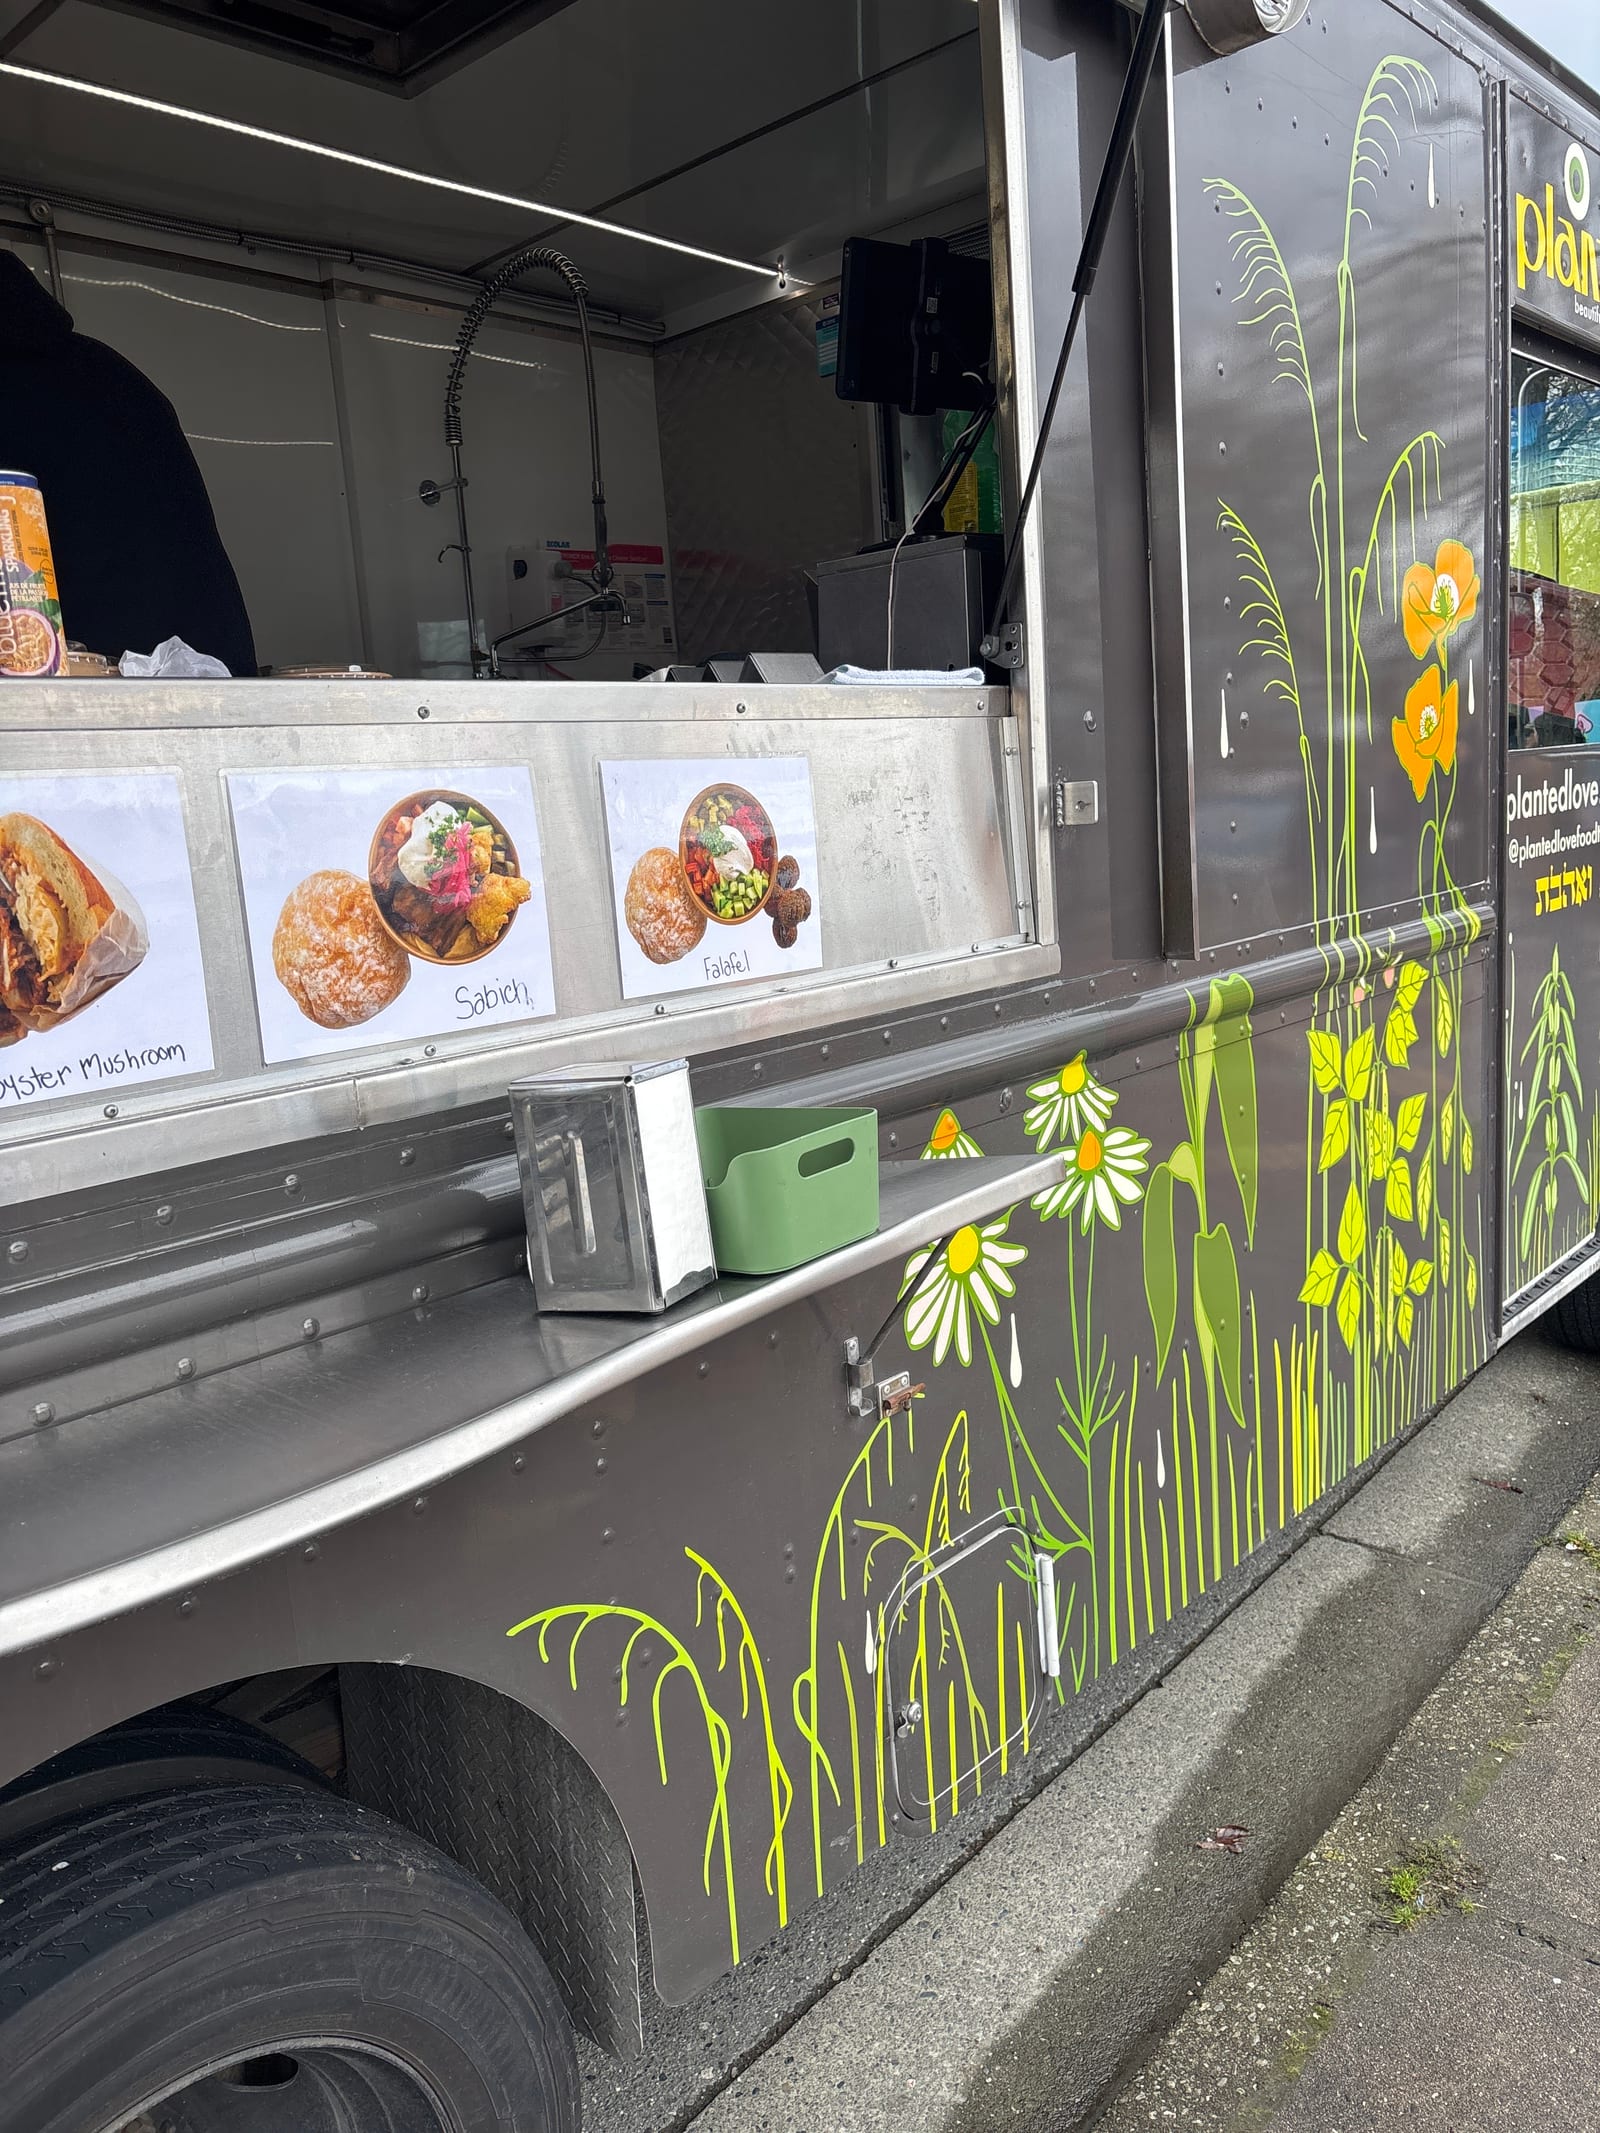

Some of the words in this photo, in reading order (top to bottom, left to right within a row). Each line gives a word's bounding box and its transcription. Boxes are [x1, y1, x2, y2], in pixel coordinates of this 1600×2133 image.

[1516, 183, 1600, 303] plan
[0, 509, 19, 572] SPARKLING
[704, 949, 750, 981] Falafel
[79, 1043, 186, 1080] Mushroom
